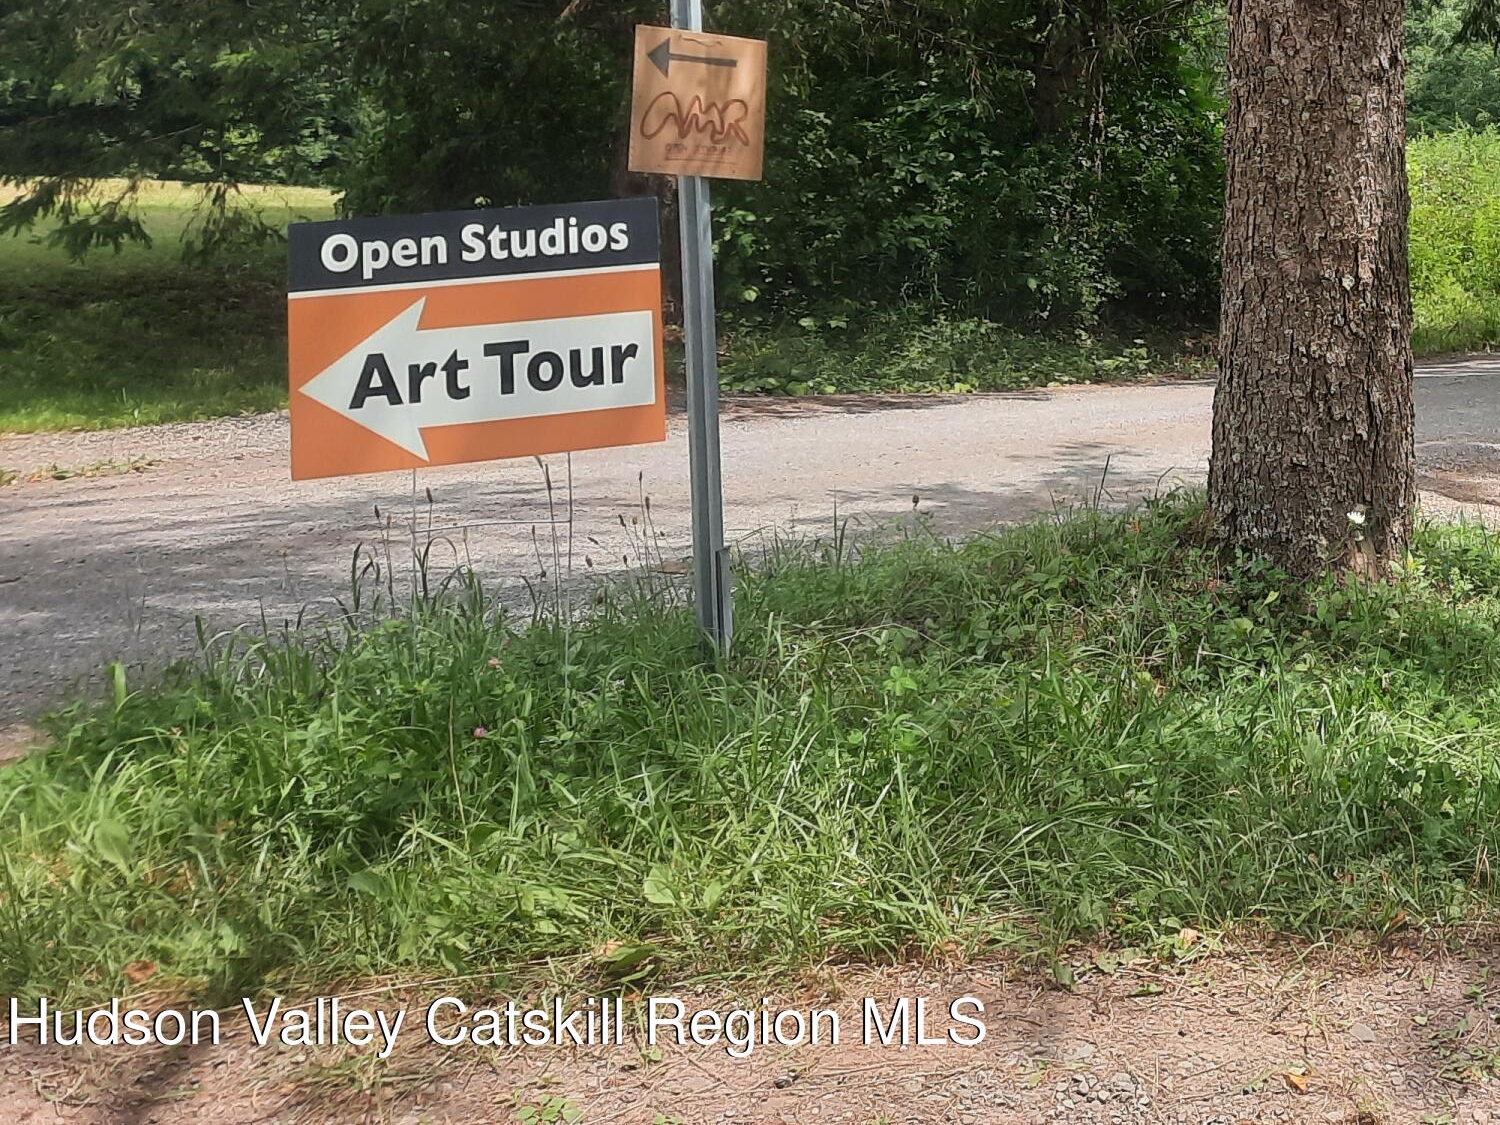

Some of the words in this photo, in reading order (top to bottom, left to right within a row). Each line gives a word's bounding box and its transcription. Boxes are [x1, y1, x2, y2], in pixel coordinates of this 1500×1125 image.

[320, 233, 448, 280] Open
[460, 216, 629, 263] Studios
[348, 349, 471, 410] Art
[483, 339, 639, 395] Tour
